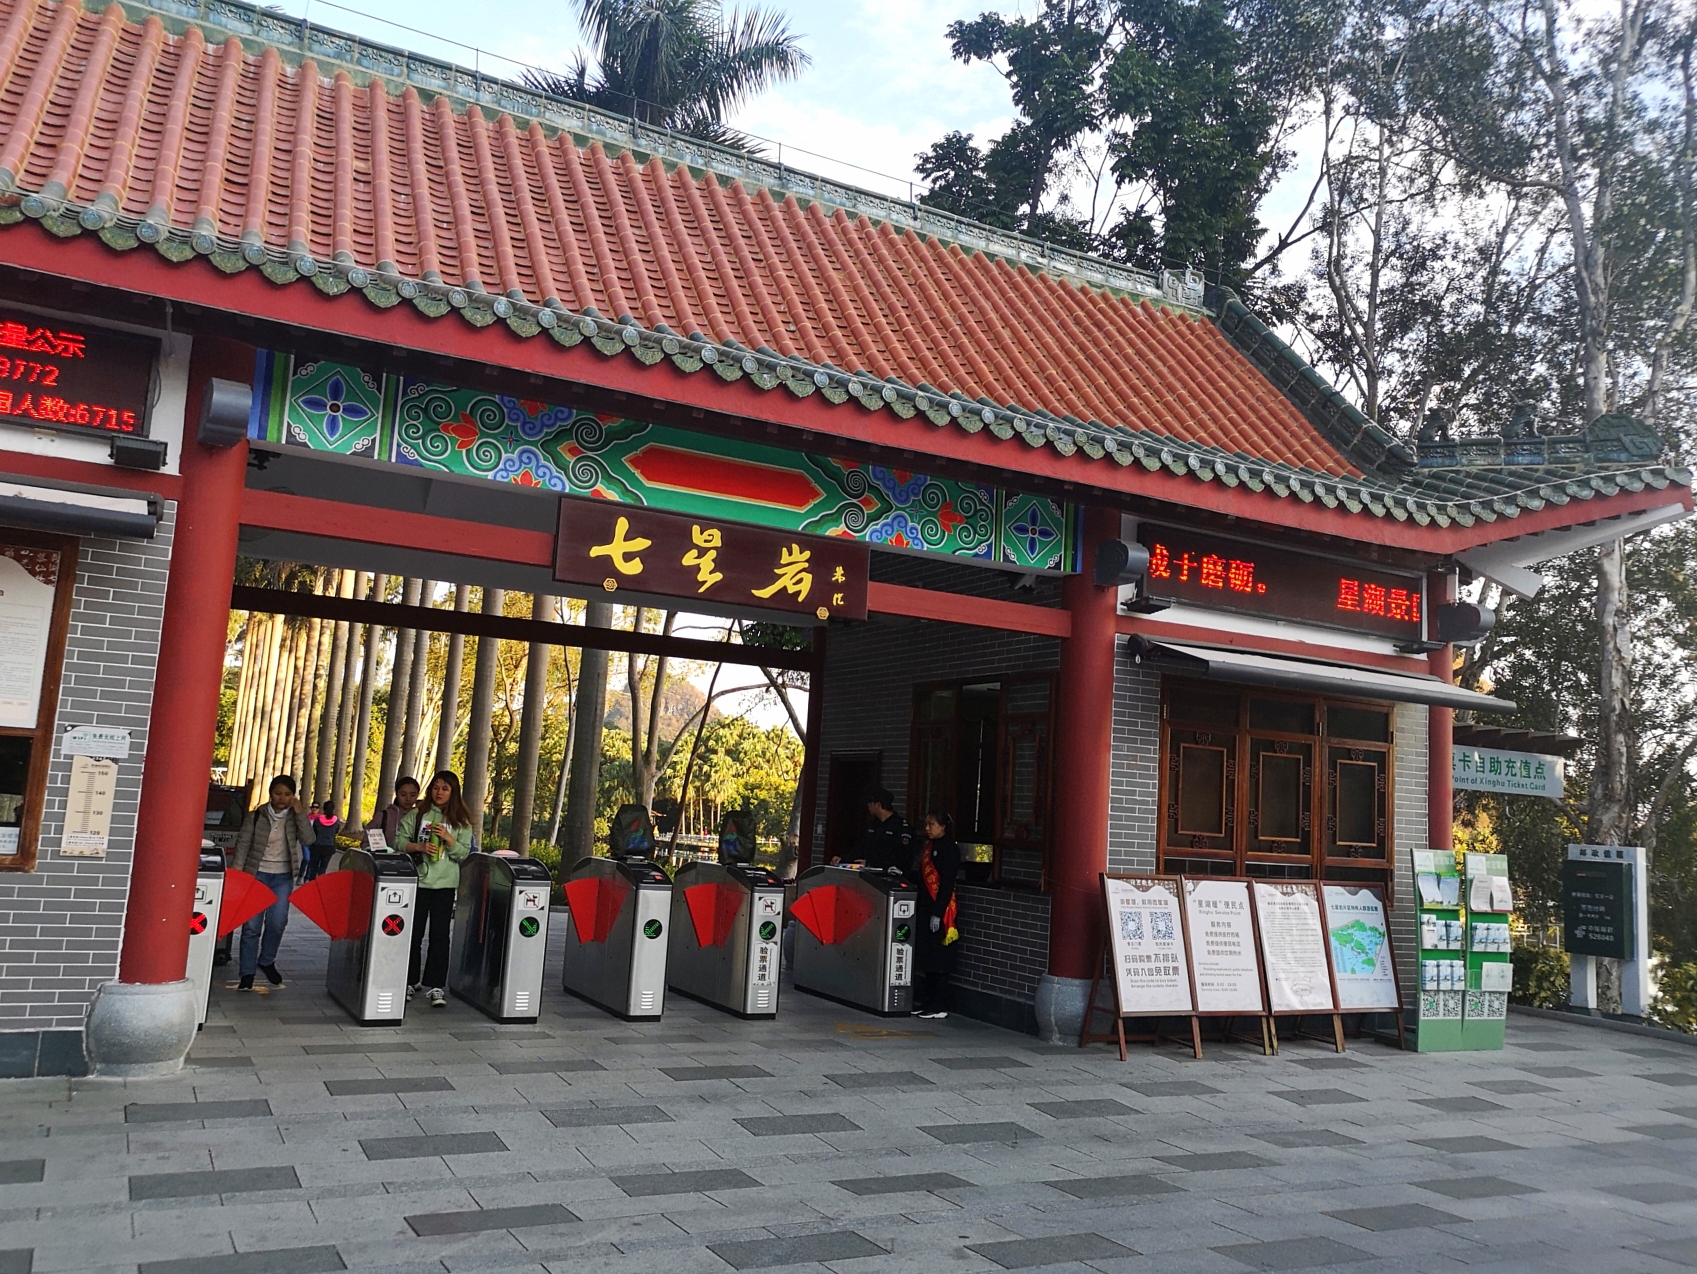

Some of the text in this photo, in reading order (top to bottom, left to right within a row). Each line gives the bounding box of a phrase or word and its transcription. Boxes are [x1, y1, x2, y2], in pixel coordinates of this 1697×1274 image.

[589, 516, 813, 602] 七星岩
[1470, 776, 1478, 784] of
[1480, 777, 1505, 788] Xinghu
[1507, 780, 1528, 790] Ticket
[1530, 783, 1546, 791] Card
[757, 946, 769, 982] 验票通道
[1124, 953, 1179, 964] 扫码购票不排队
